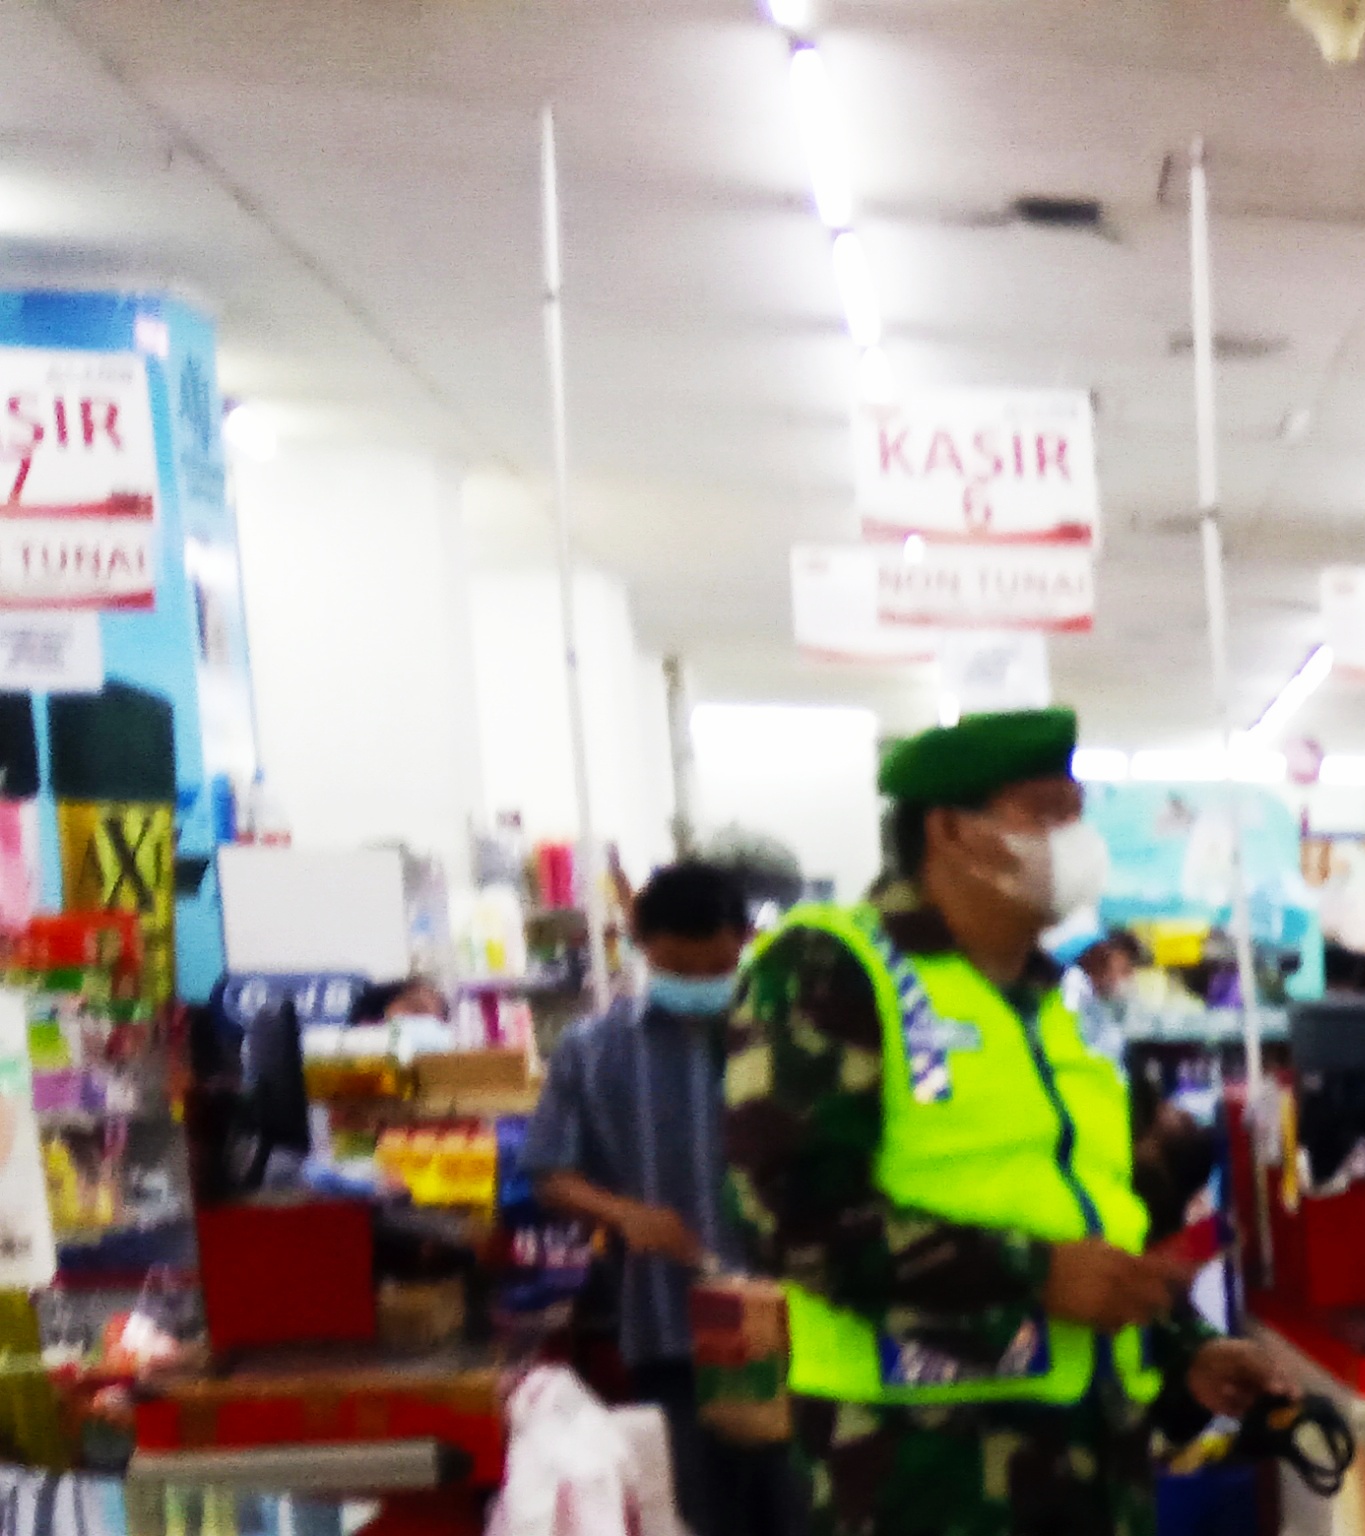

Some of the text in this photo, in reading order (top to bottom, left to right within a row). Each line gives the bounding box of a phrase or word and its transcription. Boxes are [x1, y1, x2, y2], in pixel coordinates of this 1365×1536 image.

[0, 394, 123, 450] SIR
[877, 427, 1073, 481] KASIR
[21, 546, 145, 577] TUNAI
[877, 567, 1085, 596] NON TUNAI
